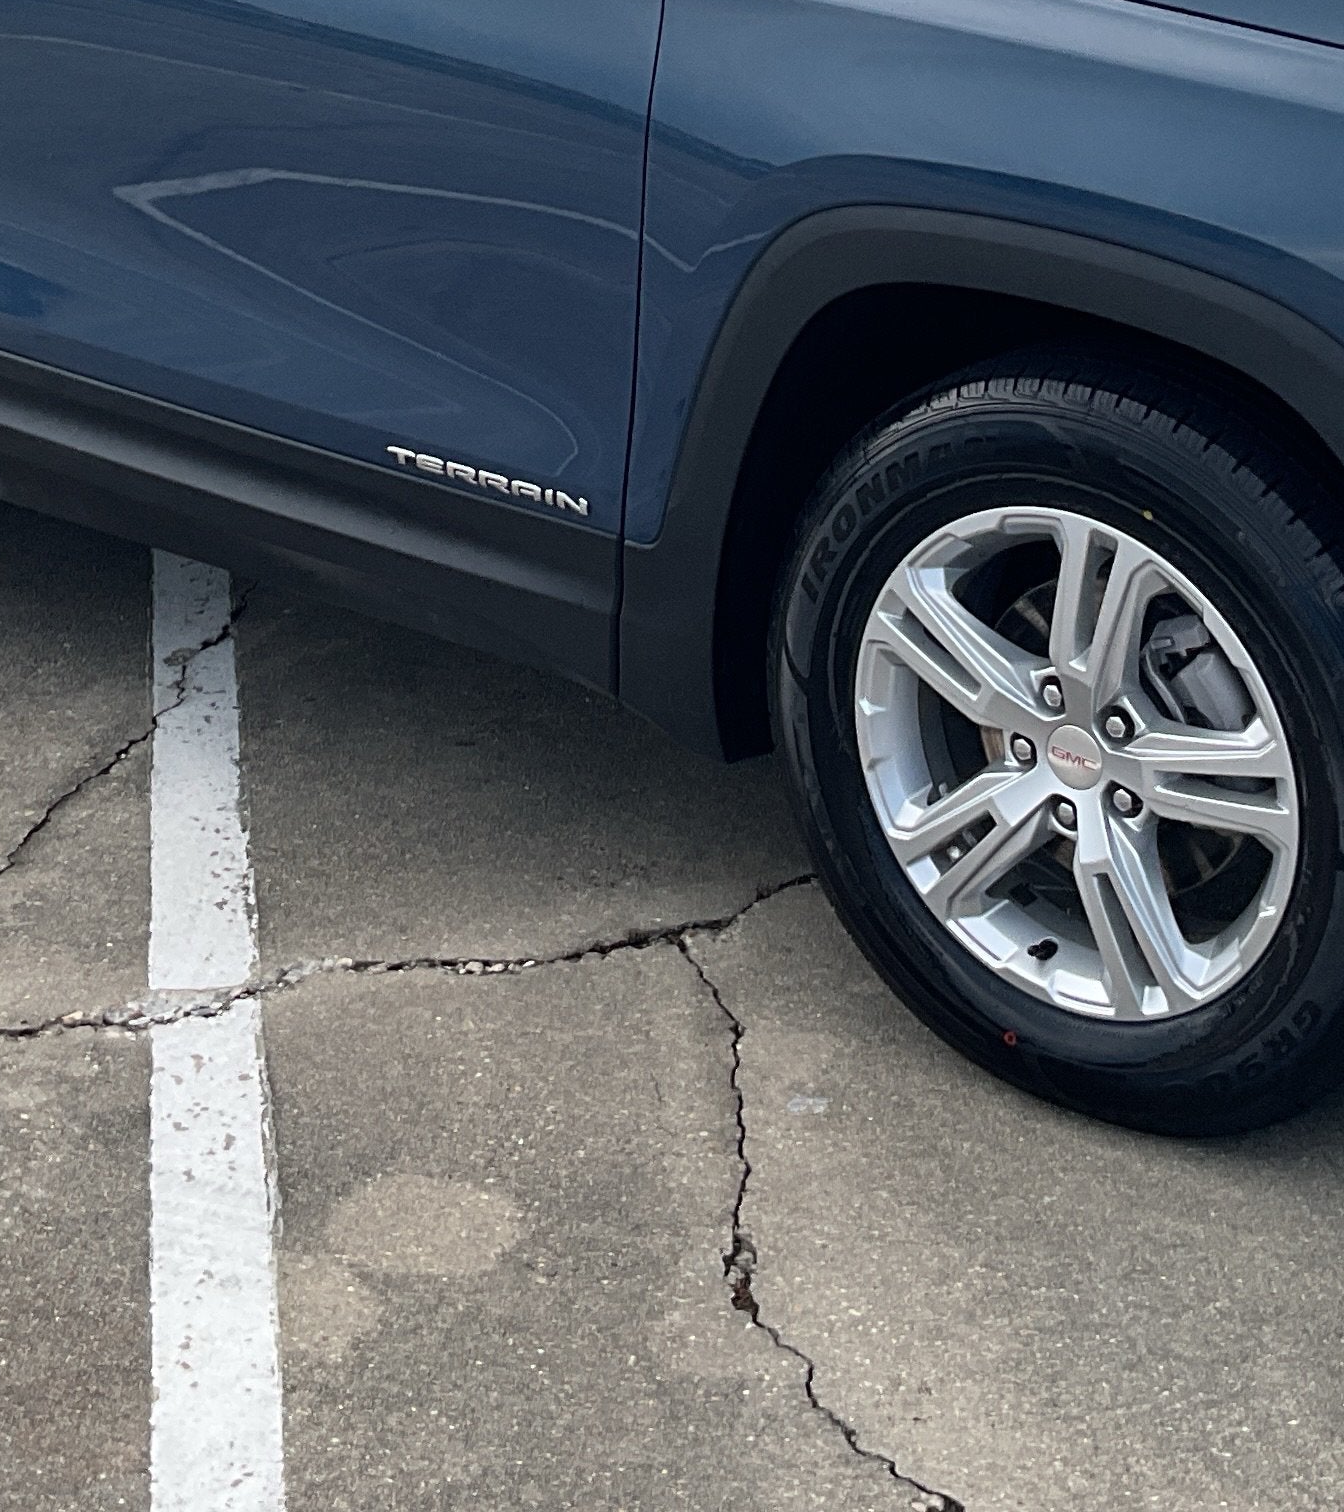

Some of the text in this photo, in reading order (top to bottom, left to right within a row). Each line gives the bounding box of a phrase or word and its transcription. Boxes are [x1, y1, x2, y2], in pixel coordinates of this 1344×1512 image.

[386, 445, 589, 517] TERRAIN
[799, 434, 997, 606] IRONMA
[1051, 745, 1097, 772] GMC
